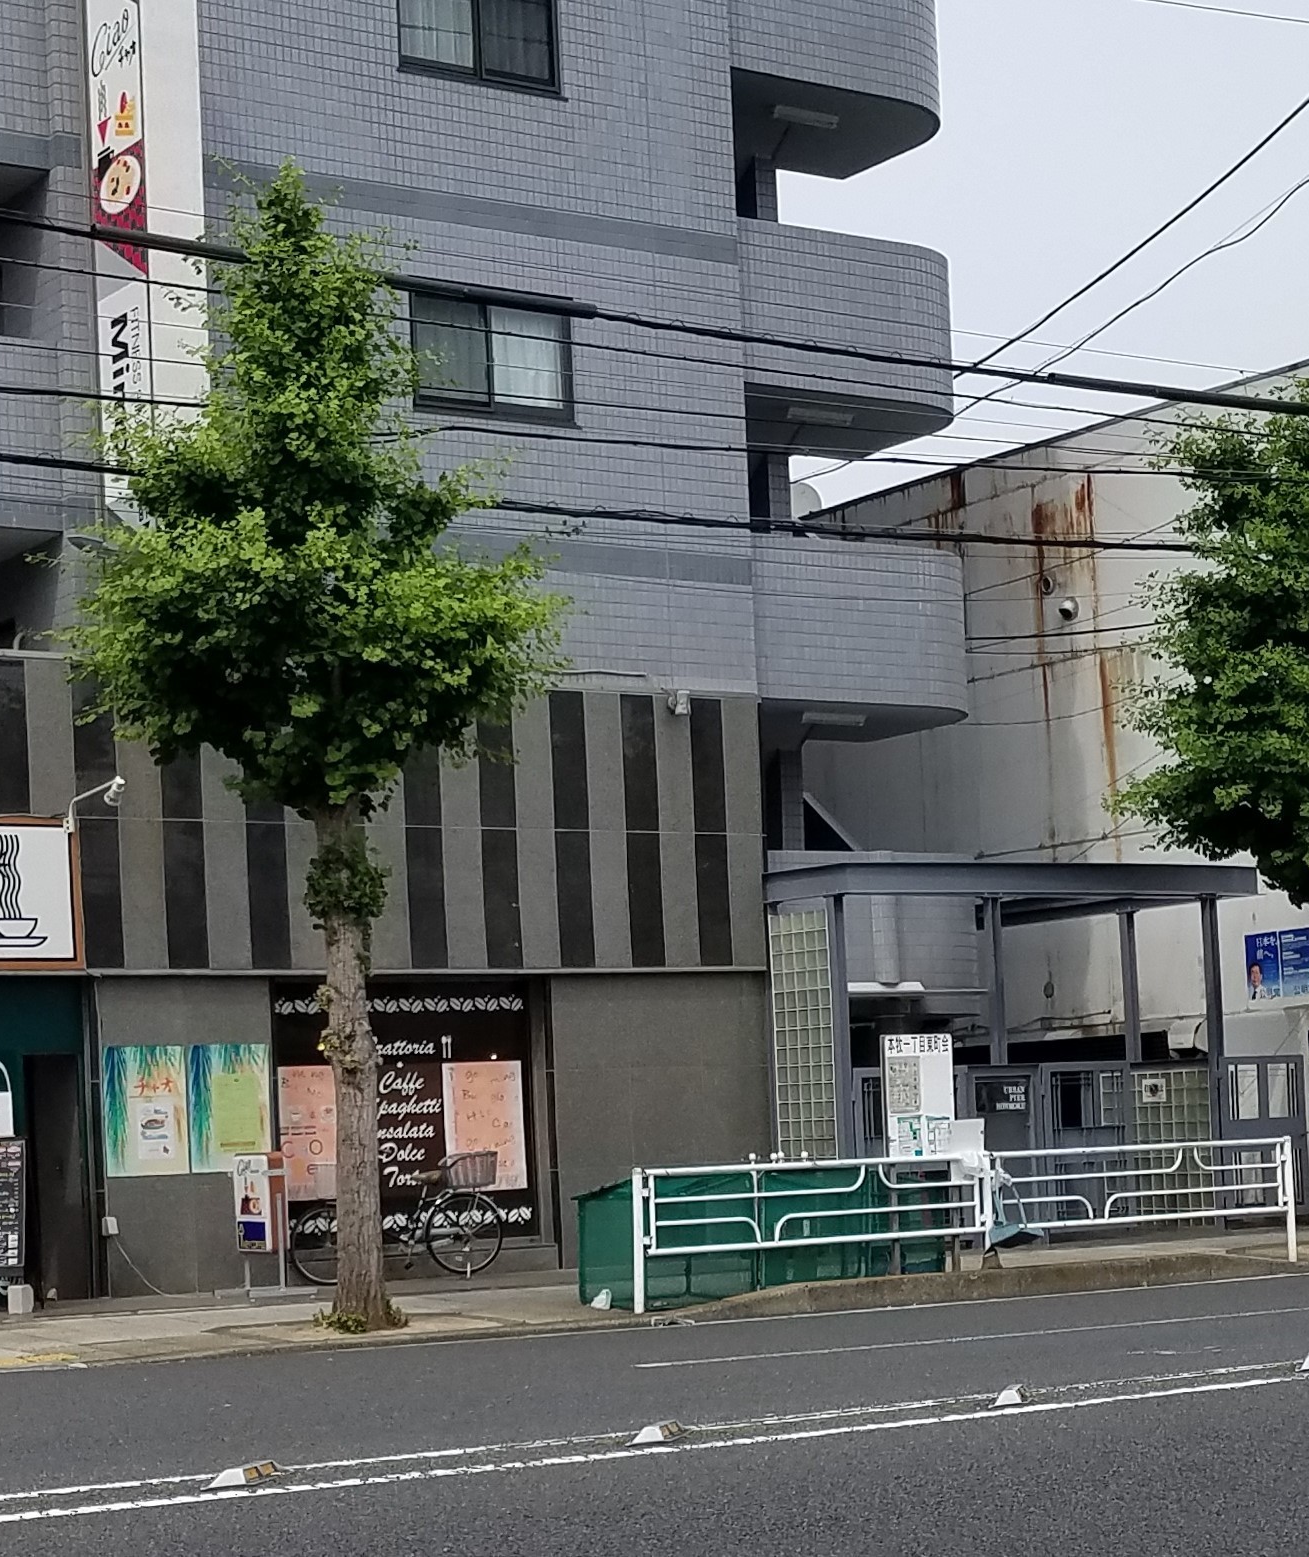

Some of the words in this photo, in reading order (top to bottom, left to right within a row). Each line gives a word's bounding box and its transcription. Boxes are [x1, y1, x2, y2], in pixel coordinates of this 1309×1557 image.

[92, 8, 129, 77] Ciao
[372, 1035, 436, 1056] rattoria
[133, 1076, 174, 1096] チャオ
[378, 1070, 425, 1096] Caffe
[377, 1094, 443, 1121] paghetti
[377, 1121, 436, 1140] nsalata
[378, 1142, 426, 1164] Dolce
